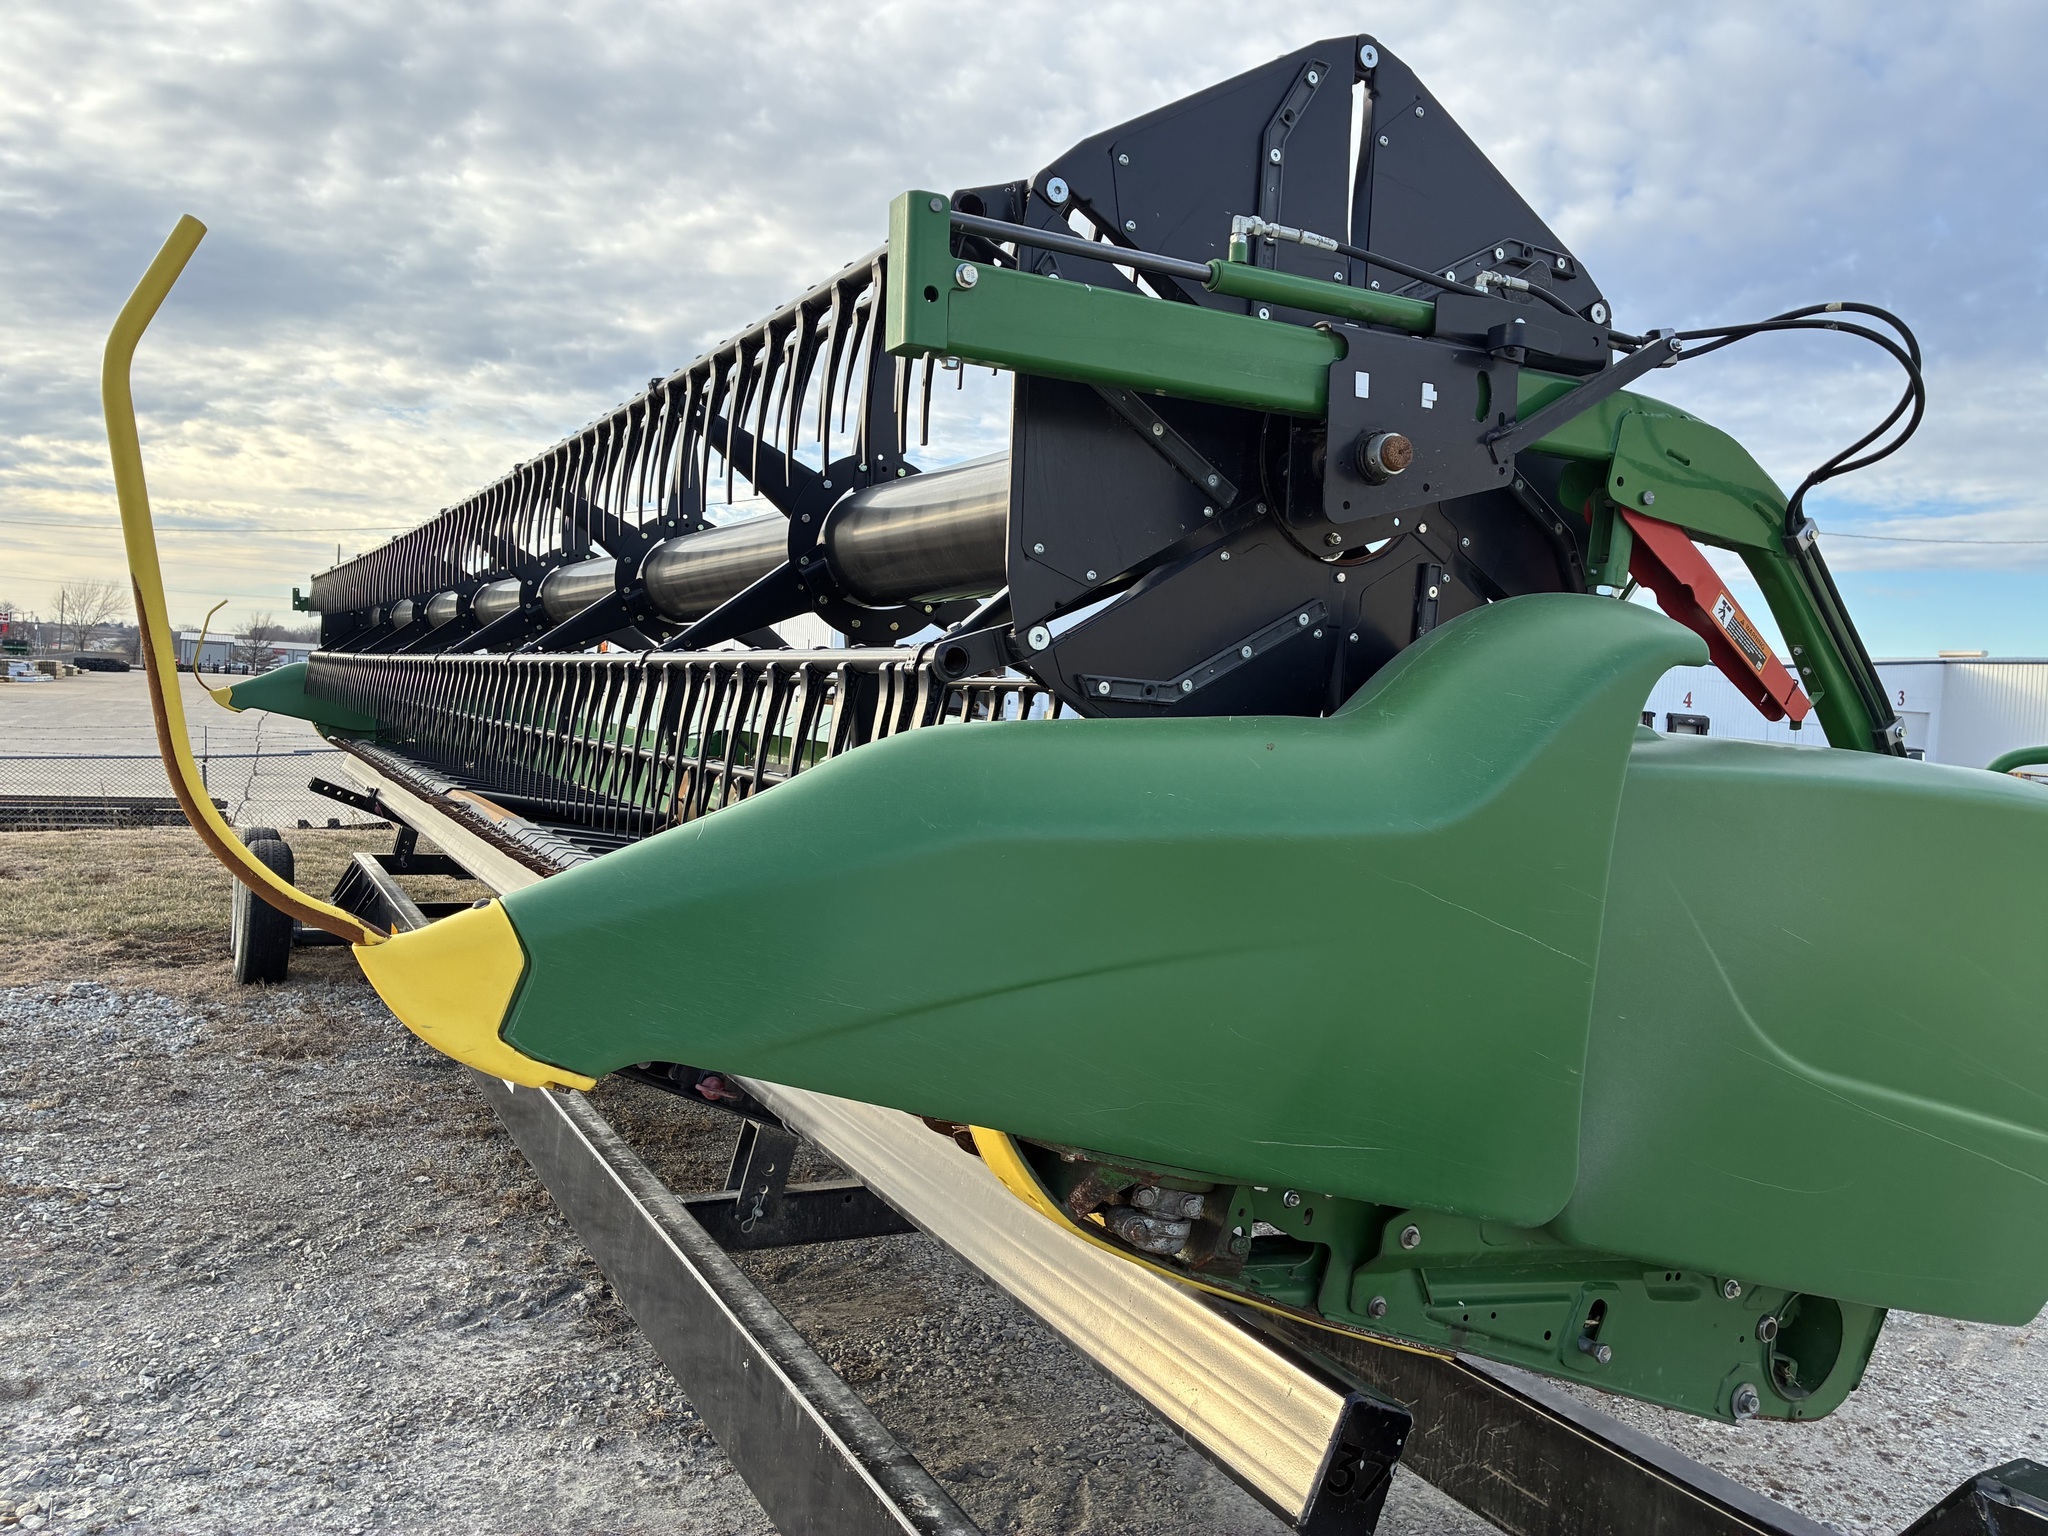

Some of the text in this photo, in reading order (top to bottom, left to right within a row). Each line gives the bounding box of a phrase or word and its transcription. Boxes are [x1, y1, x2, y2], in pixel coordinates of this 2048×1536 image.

[1745, 624, 1765, 650] WARNING
[1683, 691, 1692, 708] 4
[1897, 690, 1905, 706] 3
[1327, 1443, 1394, 1503] 37
